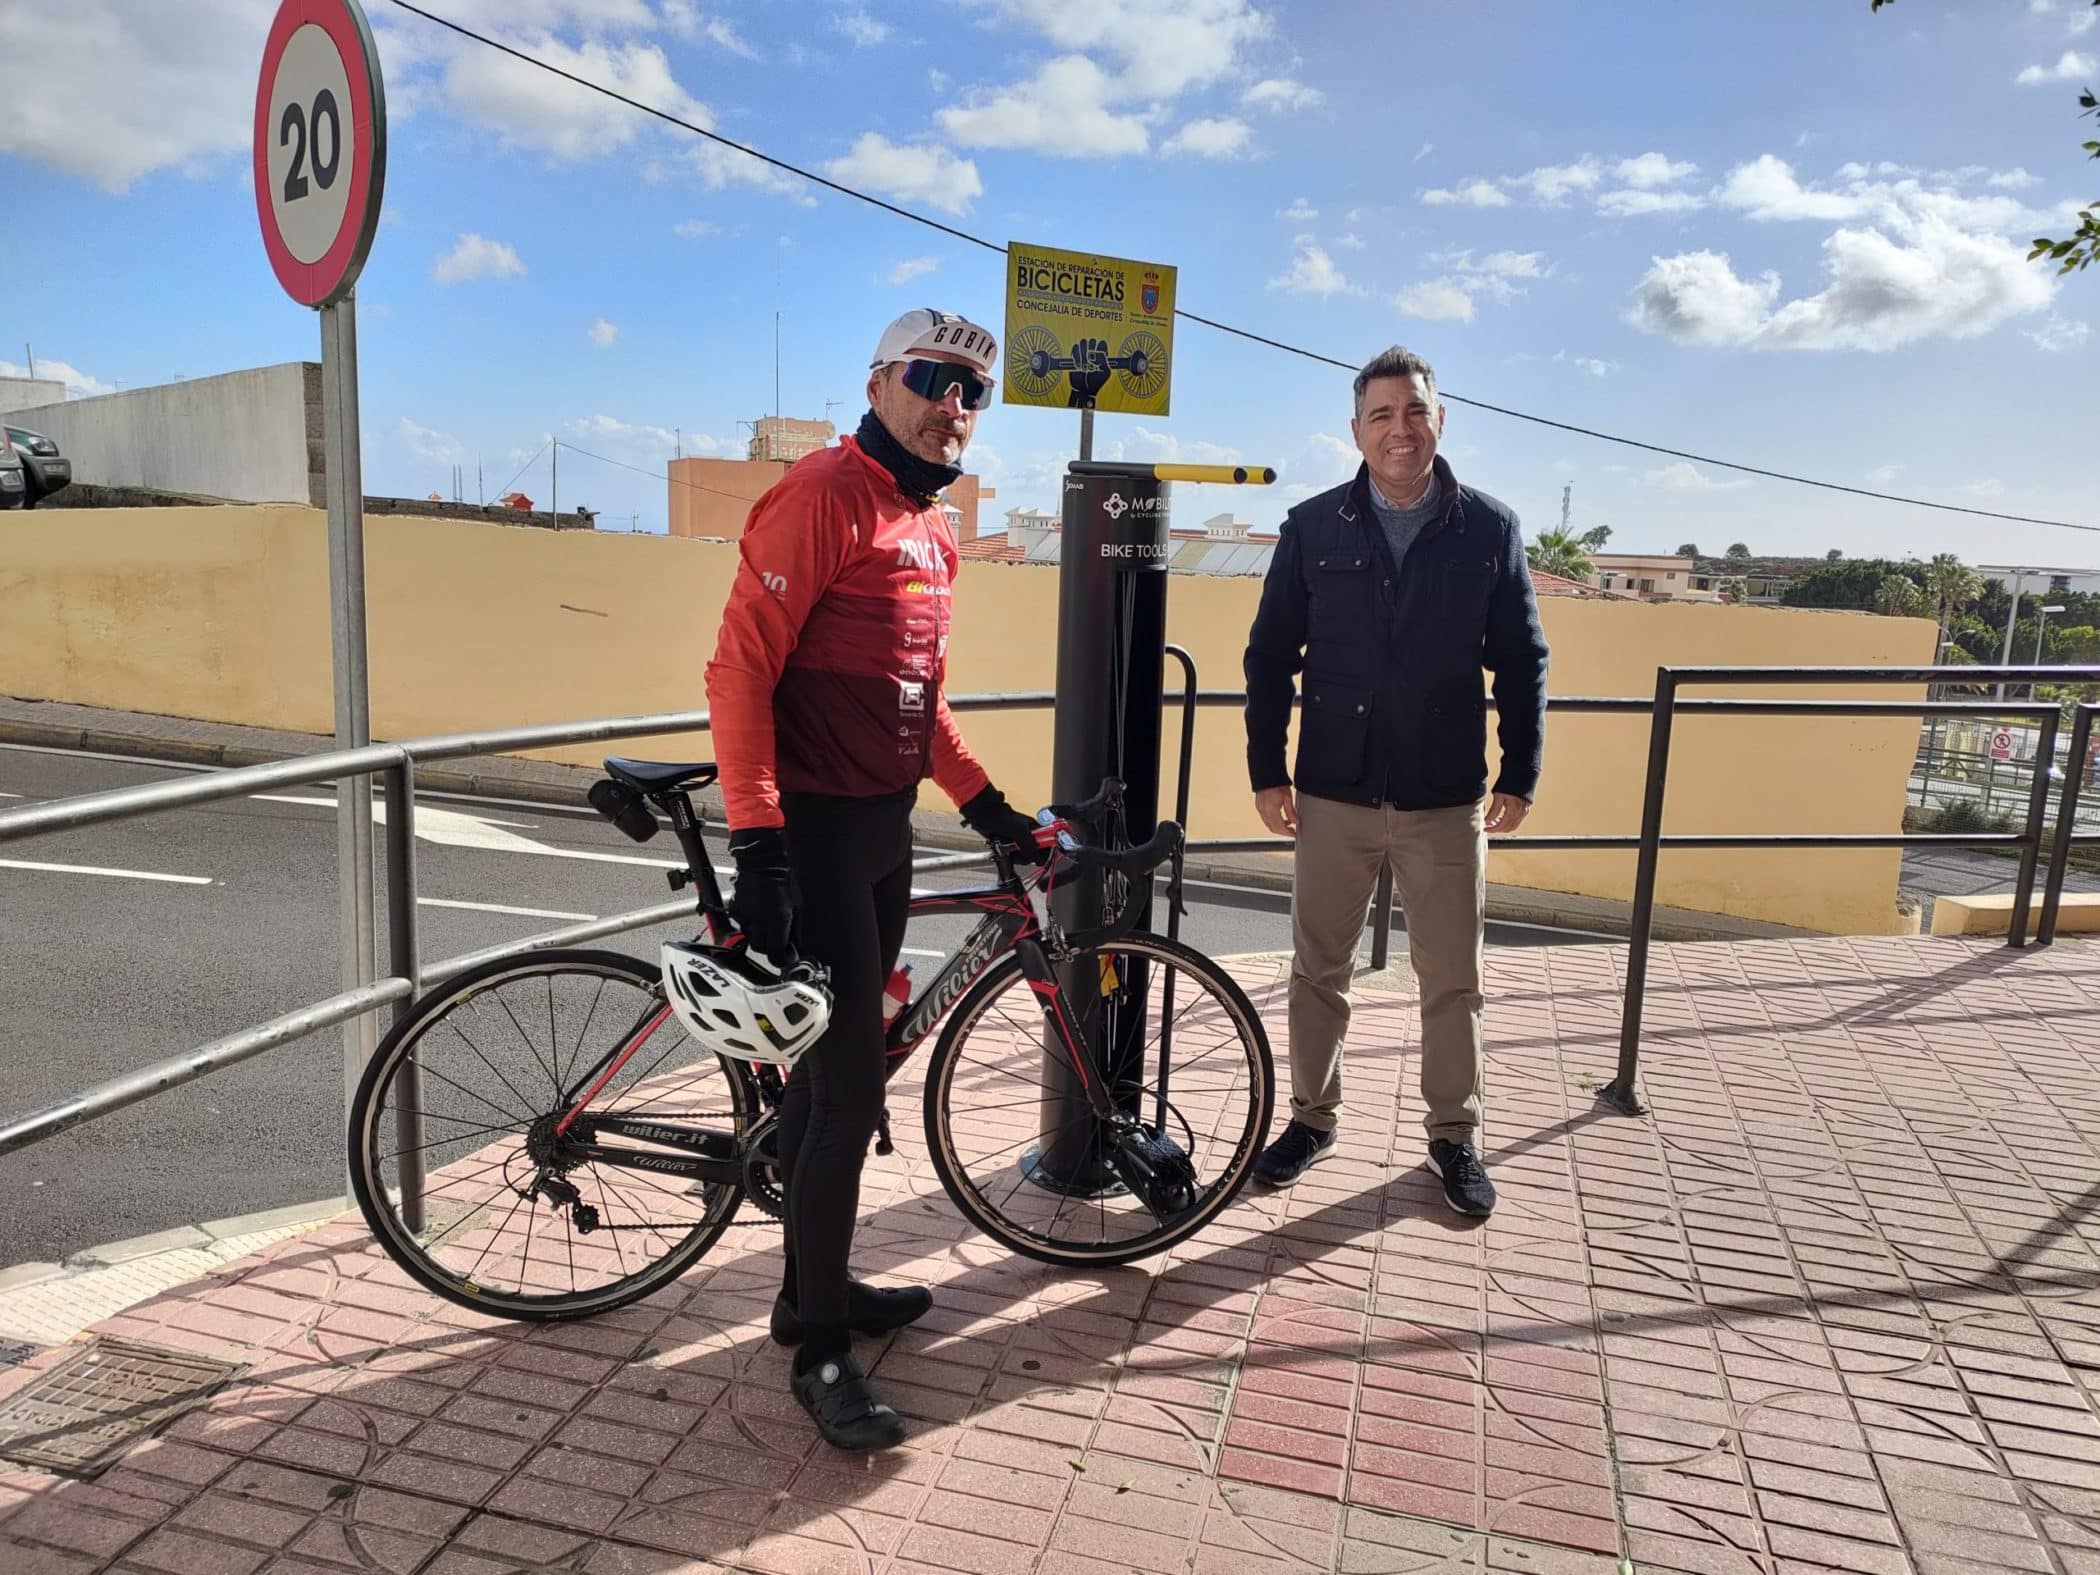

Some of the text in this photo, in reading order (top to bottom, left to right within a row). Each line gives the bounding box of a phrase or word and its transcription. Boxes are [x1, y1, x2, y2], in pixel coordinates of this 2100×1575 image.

[280, 88, 341, 203] 20
[1018, 255, 1125, 280] ESTACIÓN DE REPARACIÓN DE
[1017, 266, 1125, 302] BICICLETAS
[1071, 306, 1081, 317] DE
[1084, 308, 1123, 322] DEPORTES
[934, 326, 995, 360] GOBIK
[1101, 543, 1168, 558] BIKE TOOLS
[762, 571, 787, 593] 10
[687, 958, 731, 988] LAZER
[902, 928, 1003, 1043] Wilier
[794, 991, 820, 1008] LAZER
[622, 1124, 711, 1145] wilier.it
